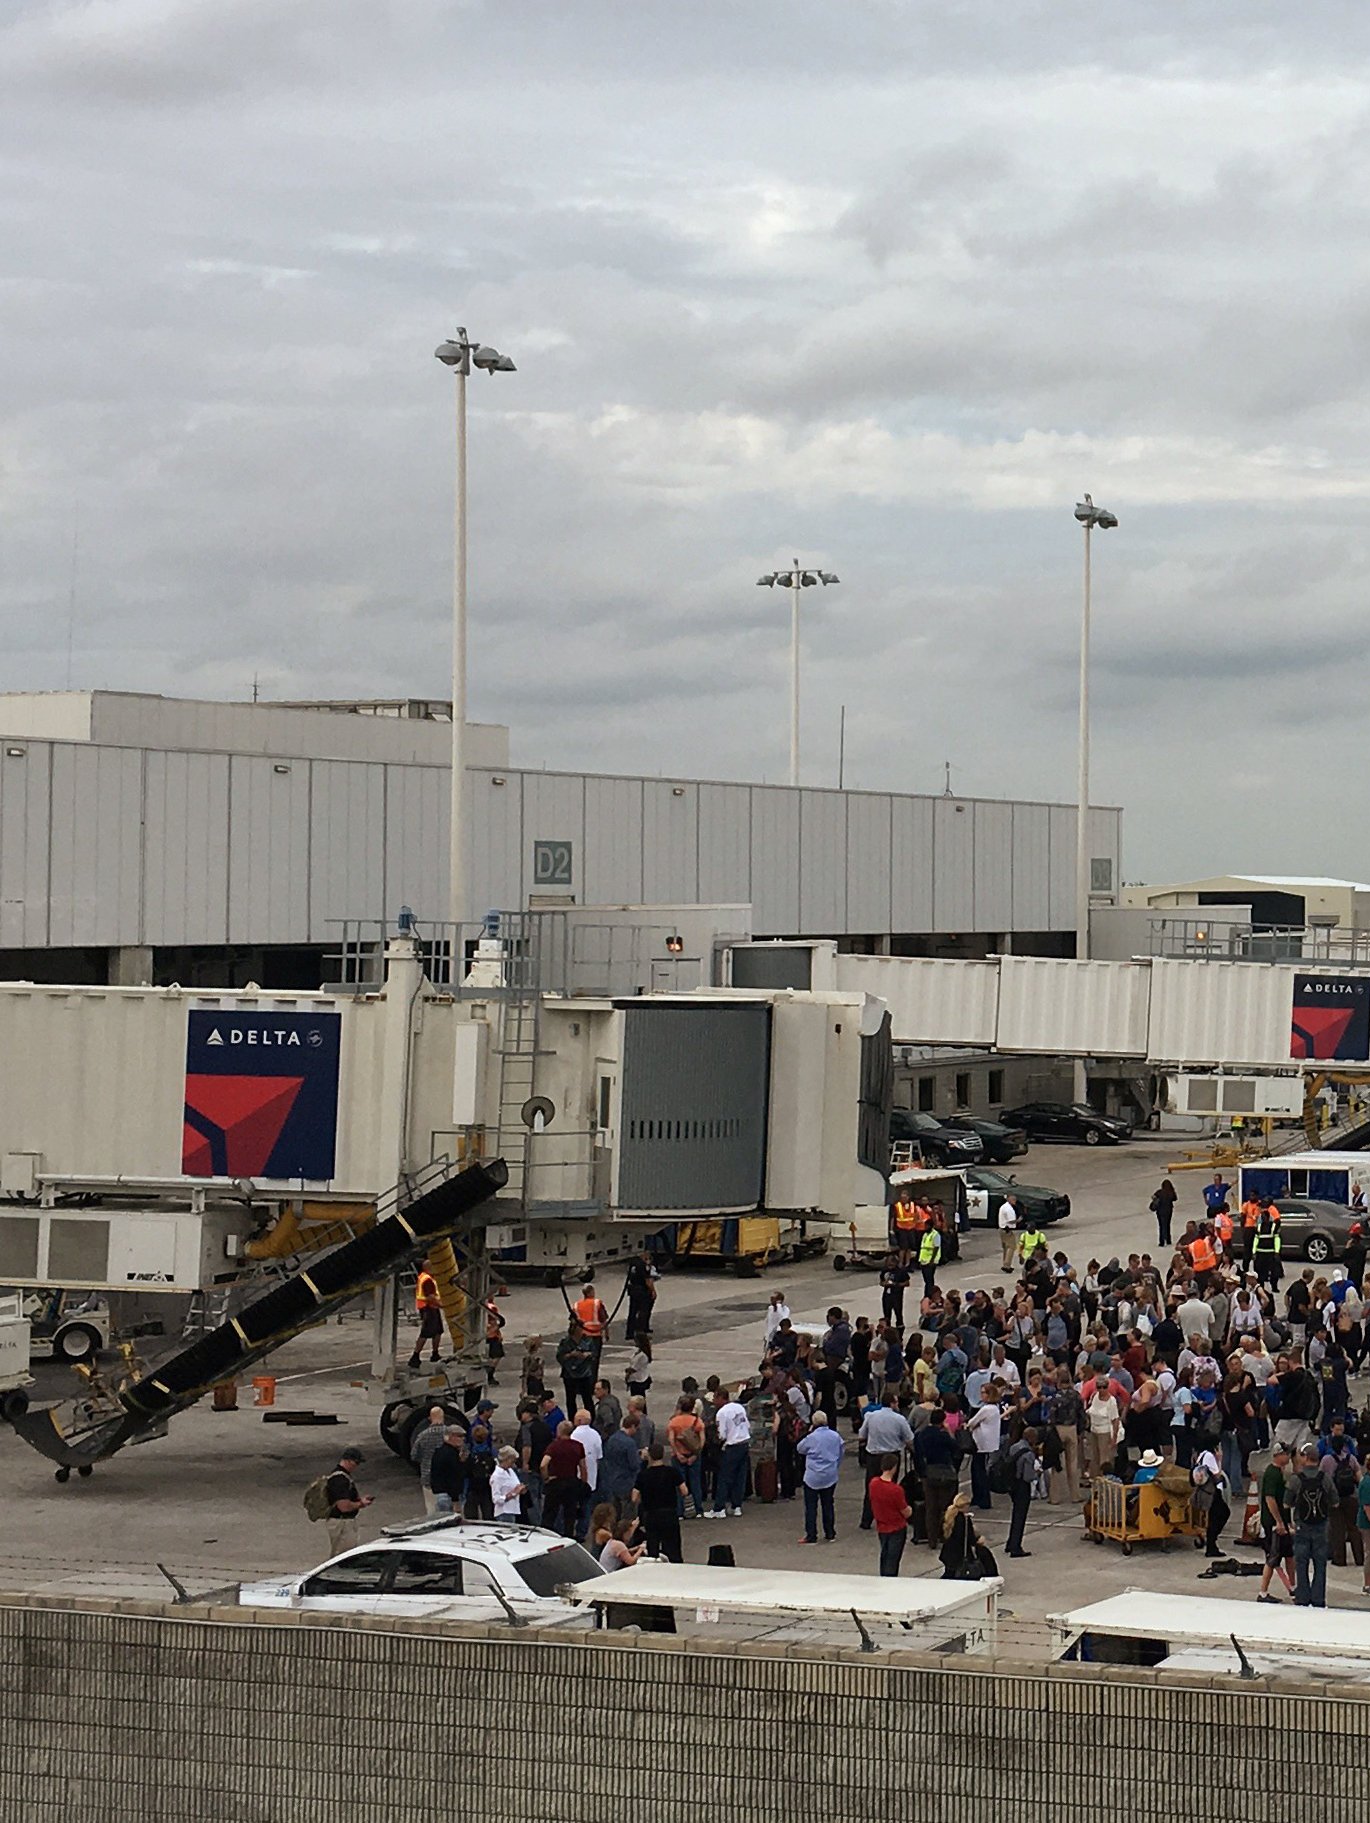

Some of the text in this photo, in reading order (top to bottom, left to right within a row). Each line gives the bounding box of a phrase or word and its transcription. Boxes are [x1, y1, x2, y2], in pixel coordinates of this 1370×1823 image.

[536, 847, 570, 878] D2
[1315, 984, 1353, 993] DELTA
[230, 1029, 301, 1046] DELTA
